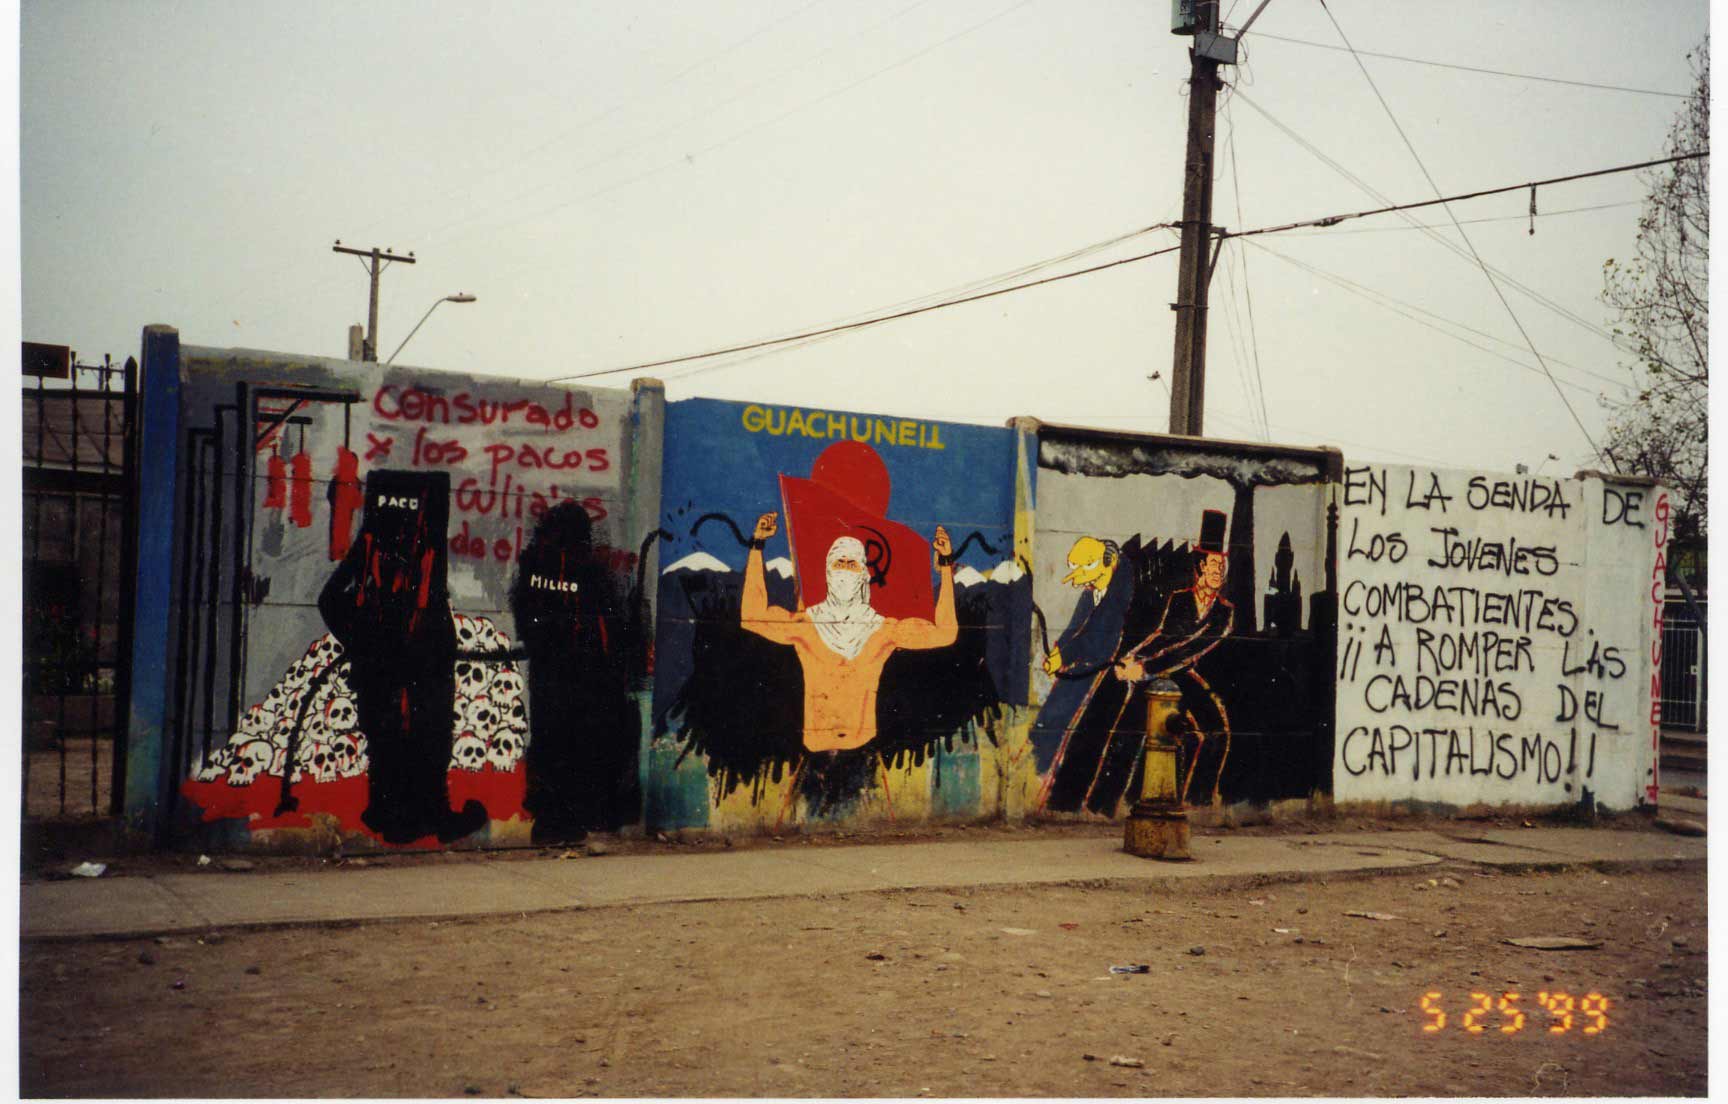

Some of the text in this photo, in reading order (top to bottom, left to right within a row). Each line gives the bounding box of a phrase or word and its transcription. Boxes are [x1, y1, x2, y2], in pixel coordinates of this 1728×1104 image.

[411, 427, 468, 467] los
[484, 442, 610, 488] pacos
[377, 495, 419, 510] PACO
[1343, 467, 1645, 529] EN LA SENDA DE
[1347, 518, 1559, 577] LOS JOVENES
[530, 574, 579, 593] MILICO
[1343, 580, 1579, 637] COMBATIENTES
[1416, 627, 1535, 677] ROMPER
[1562, 640, 1626, 680] LAS
[1364, 674, 1619, 731] CADENAS DEL
